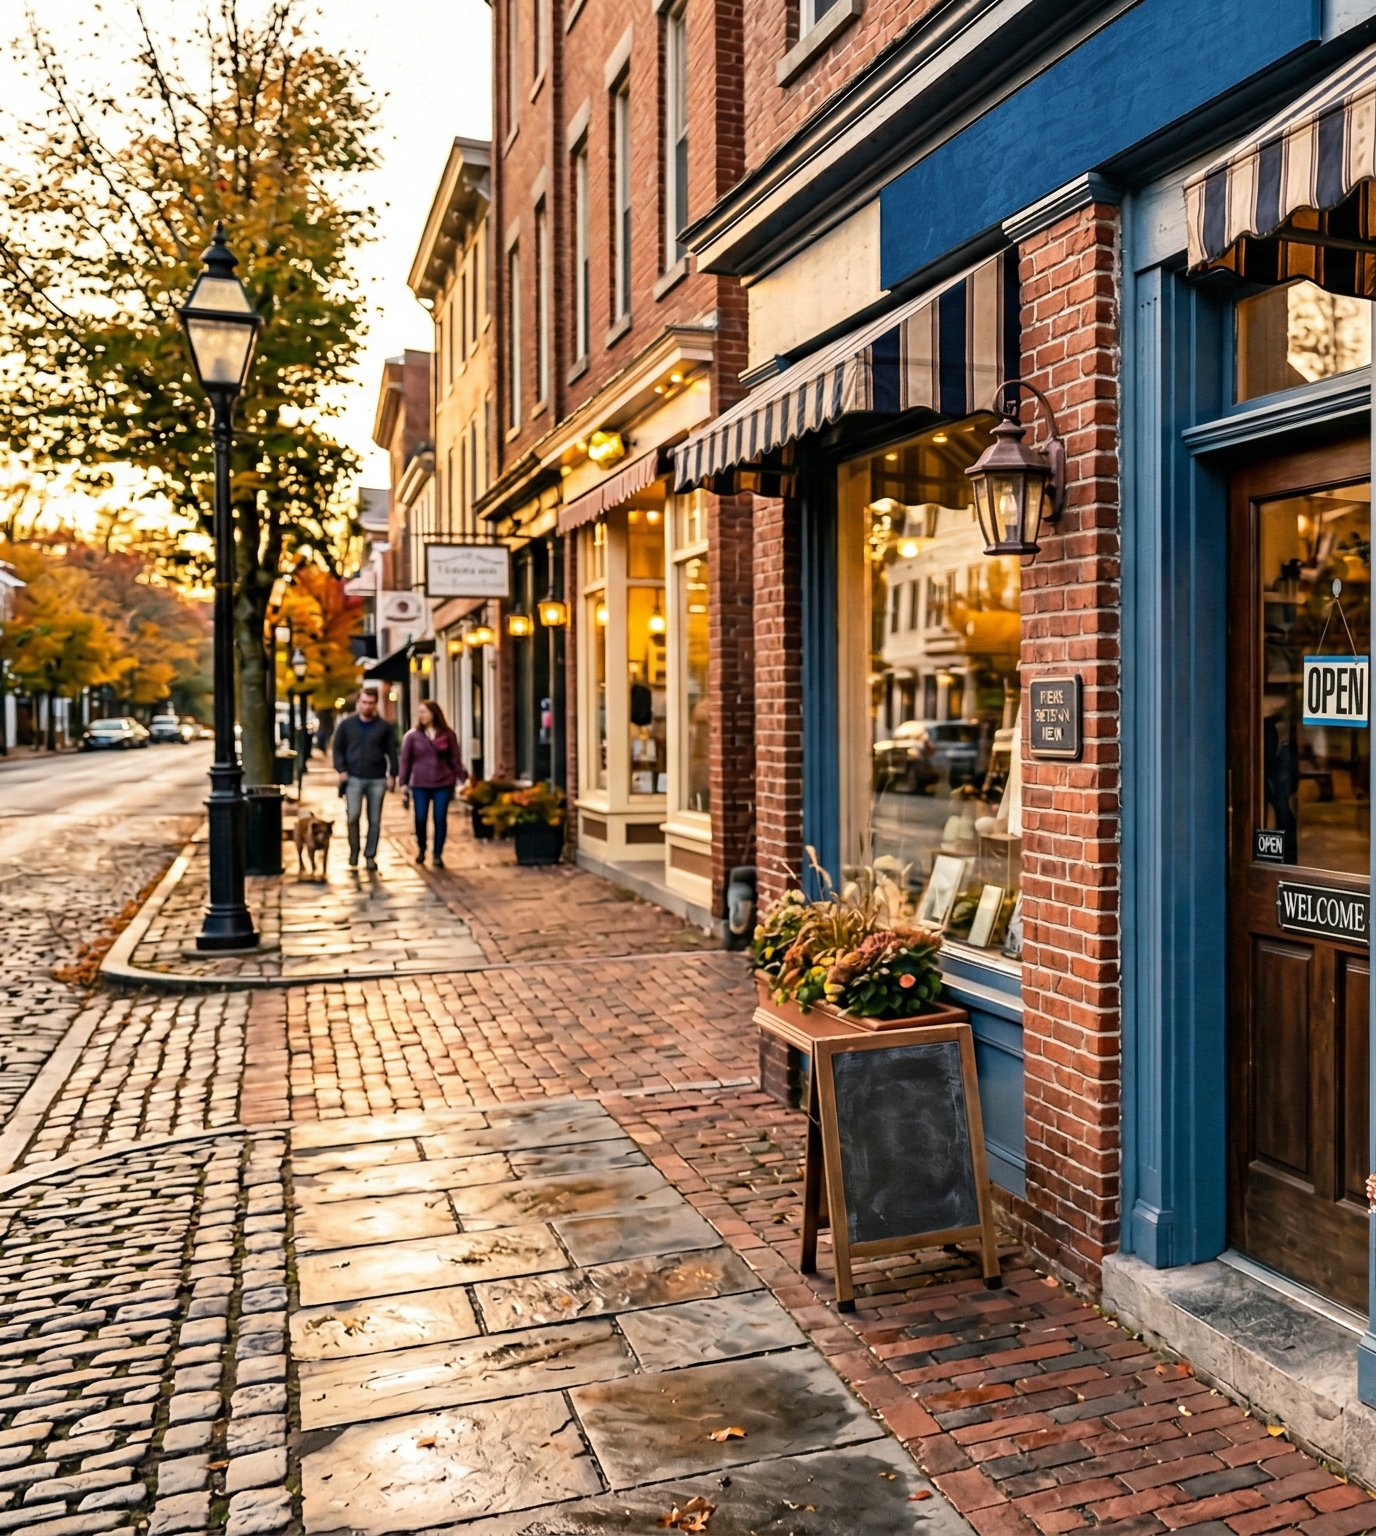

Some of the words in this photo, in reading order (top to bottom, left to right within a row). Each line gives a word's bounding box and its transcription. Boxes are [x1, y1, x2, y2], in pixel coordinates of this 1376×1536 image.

[1307, 666, 1365, 715] OPEN
[1258, 836, 1283, 854] OPEN
[1283, 891, 1366, 932] WELCOME
